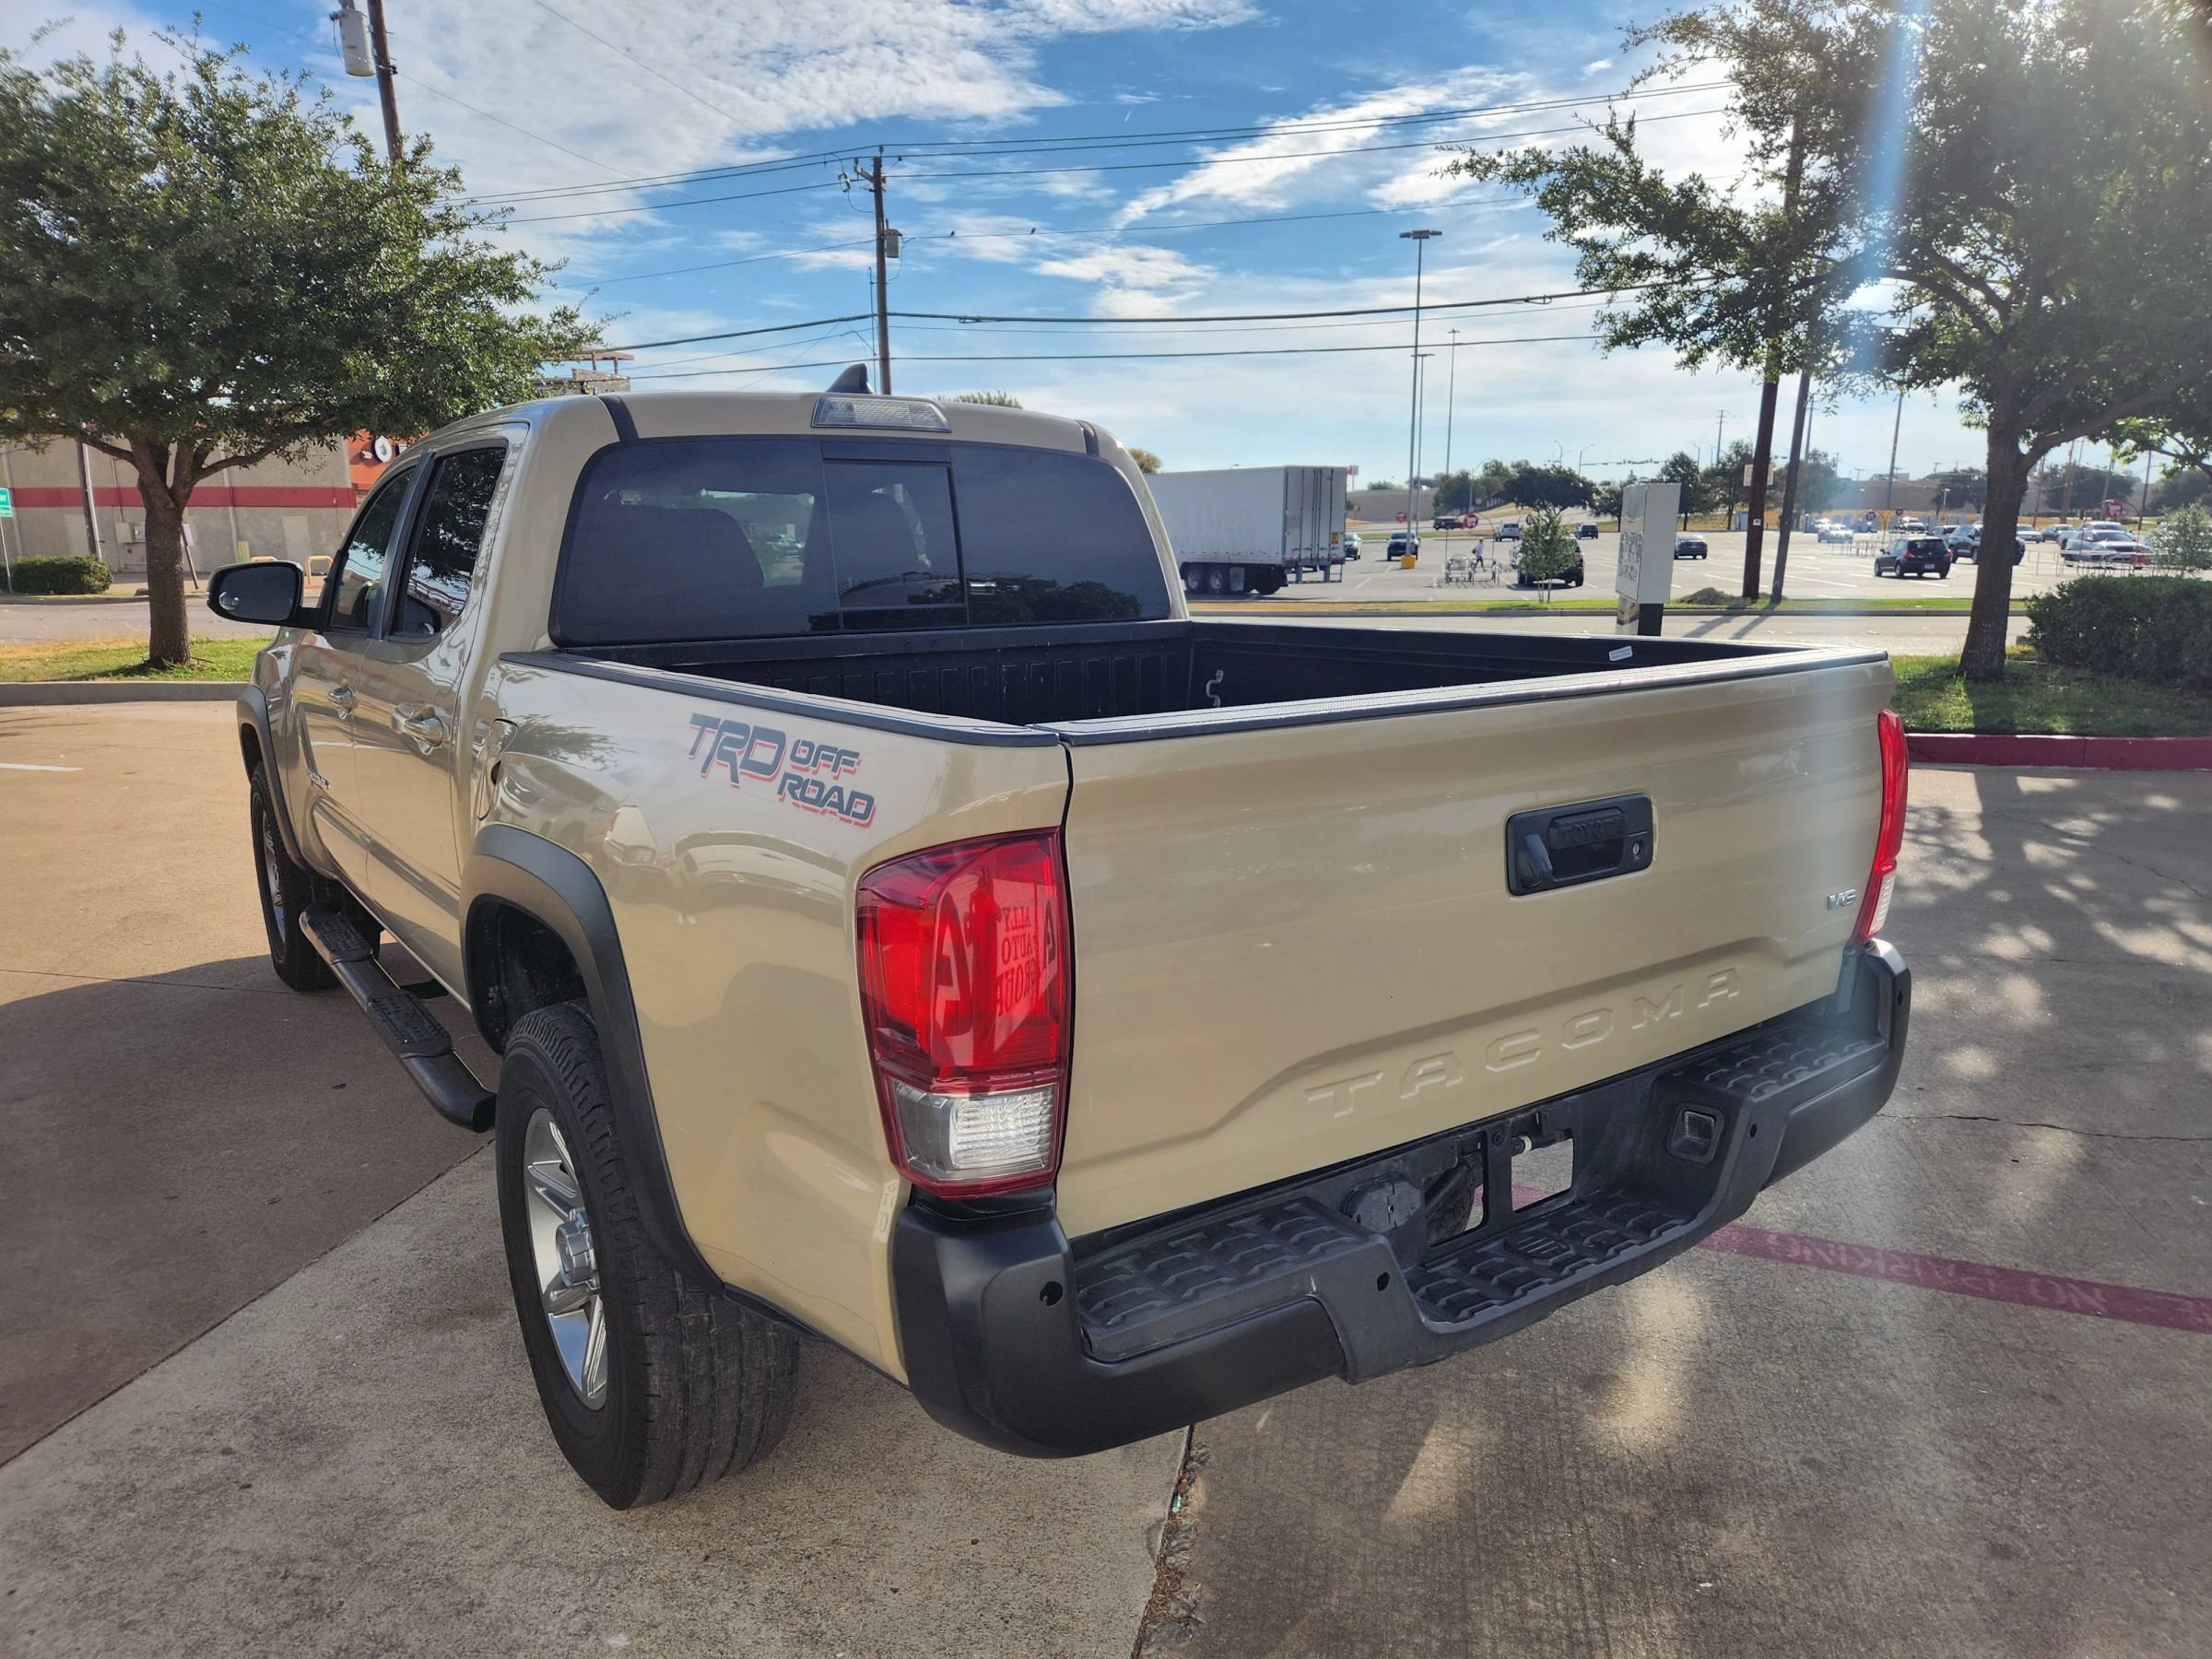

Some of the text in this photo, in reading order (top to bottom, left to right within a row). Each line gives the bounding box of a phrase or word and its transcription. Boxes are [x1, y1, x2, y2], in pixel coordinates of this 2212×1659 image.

[688, 712, 862, 789] TRD OFF
[777, 771, 876, 829] ROAD
[1827, 888, 1857, 911] V6
[1304, 967, 1741, 1118] TACOMA
